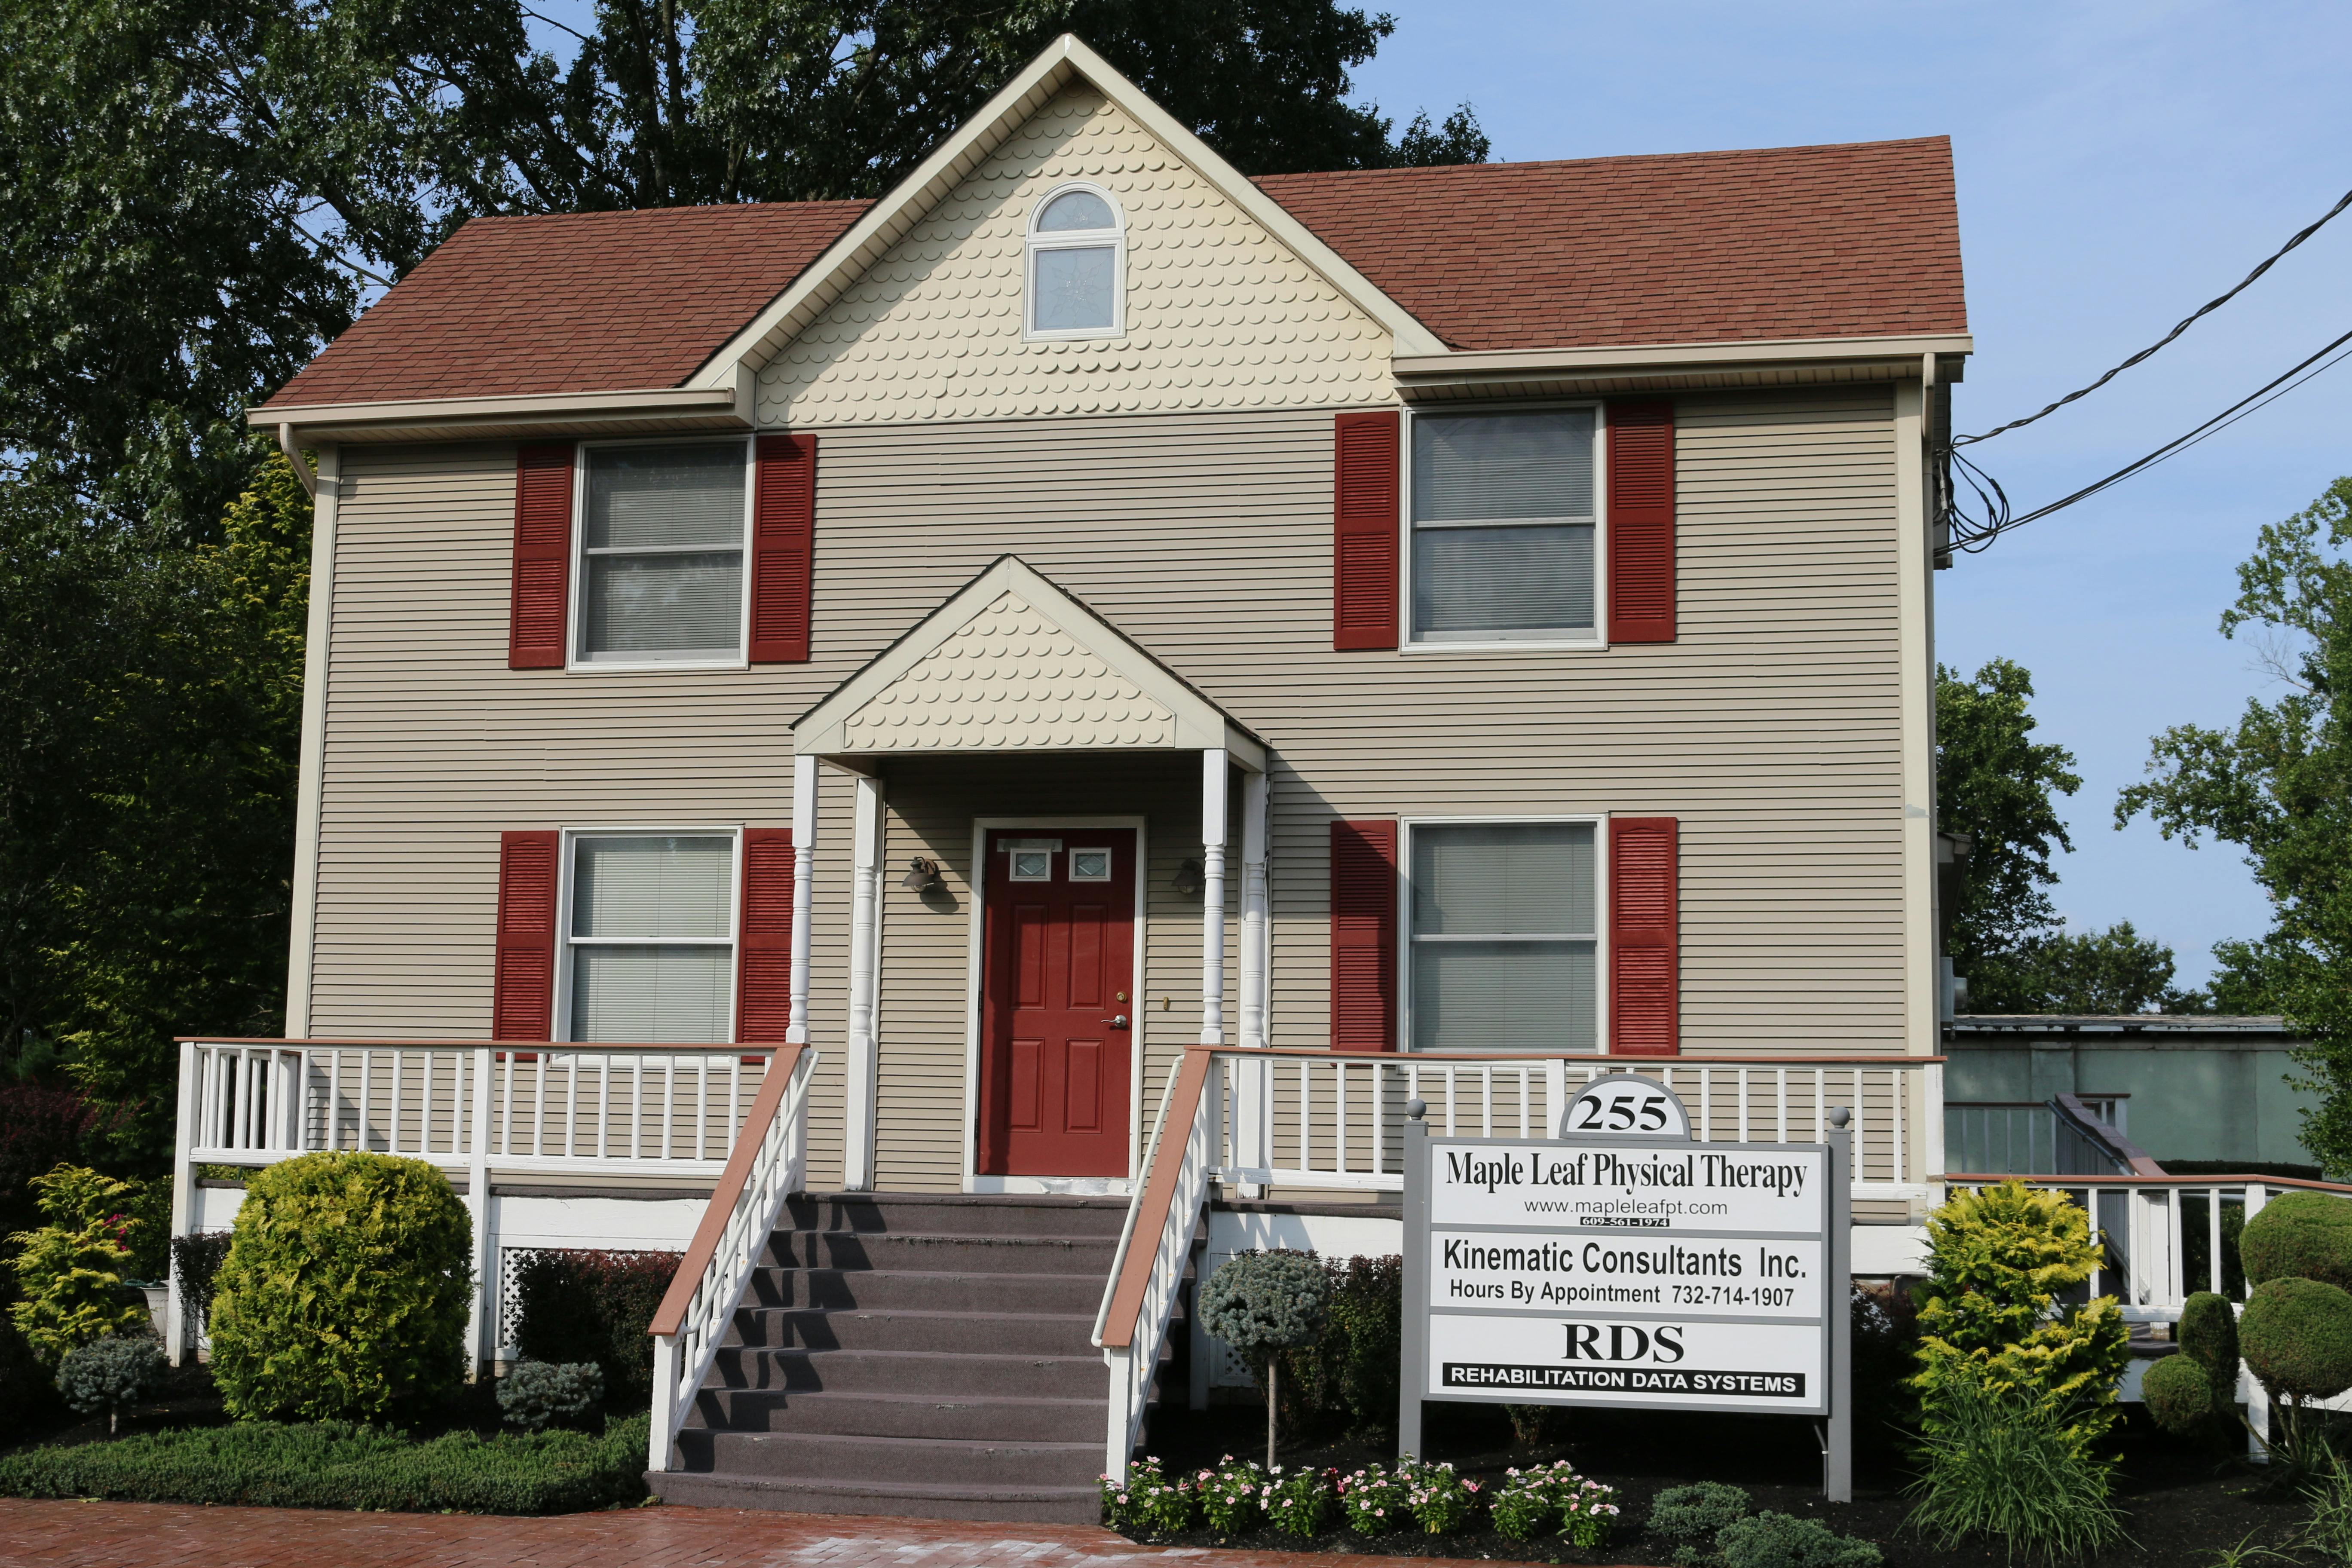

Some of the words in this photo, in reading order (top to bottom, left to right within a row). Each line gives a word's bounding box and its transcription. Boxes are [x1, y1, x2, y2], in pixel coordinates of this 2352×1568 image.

[1577, 1095, 1666, 1130] 255
[1446, 1152, 1524, 1194] Maple
[1531, 1153, 1589, 1185] Leaf
[1593, 1154, 1694, 1195] Physical
[1700, 1155, 1808, 1197] Therapy
[1524, 1199, 1727, 1217] www.mapleleafpt.com
[1582, 1217, 1667, 1226] 609-561-1974
[1444, 1239, 1573, 1272] Kinematic
[1583, 1242, 1742, 1277] Consultants
[1761, 1247, 1806, 1278] Inc.
[1451, 1279, 1504, 1298] Hours
[1511, 1280, 1534, 1304] By
[1540, 1281, 1660, 1305] Appointment
[1672, 1285, 1794, 1306] 732-714-1907
[1562, 1324, 1684, 1363] RDS
[1451, 1367, 1625, 1387] REHABILITATION
[1632, 1372, 1689, 1389] DATA
[1693, 1374, 1796, 1392] SYSTEMS
